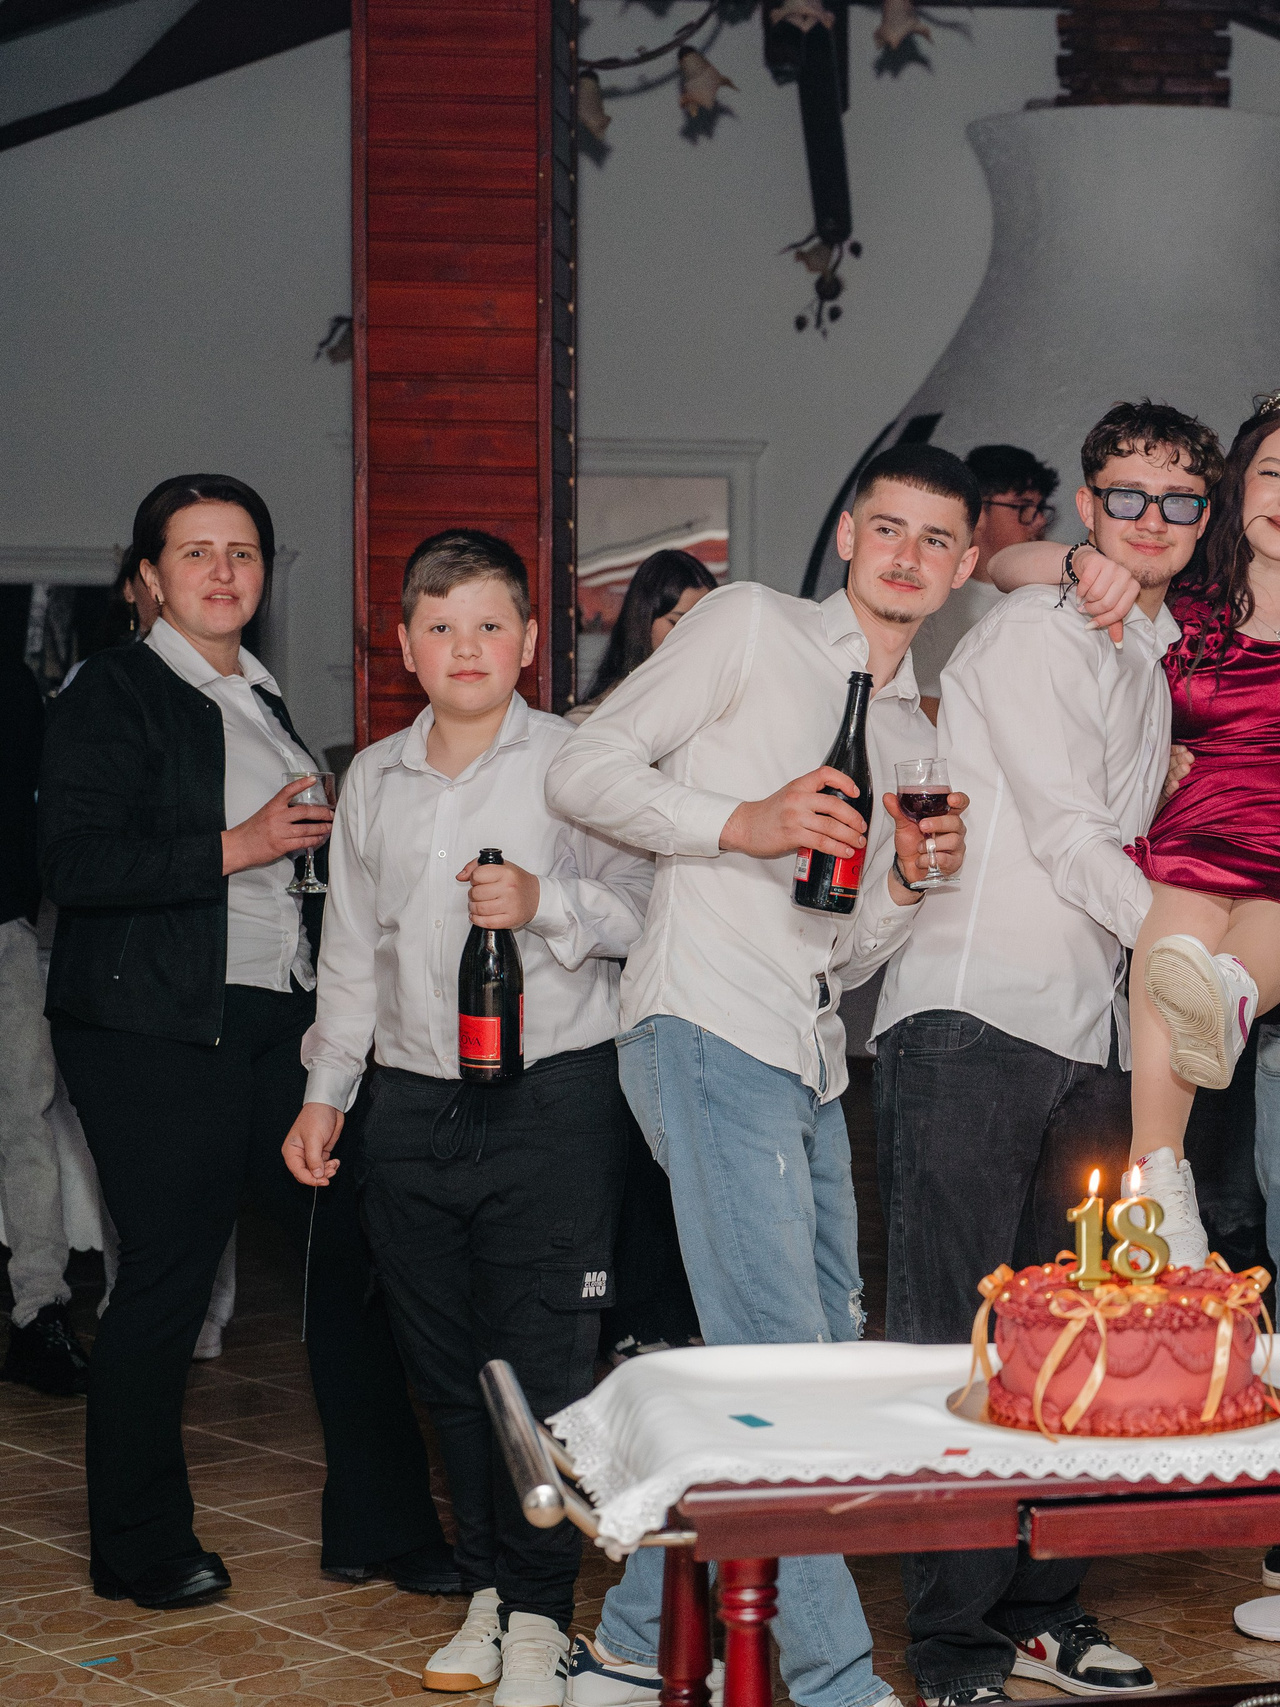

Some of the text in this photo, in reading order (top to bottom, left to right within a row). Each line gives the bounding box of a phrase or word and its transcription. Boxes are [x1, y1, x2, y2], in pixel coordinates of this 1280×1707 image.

[460, 1034, 481, 1047] OVA
[1066, 1197, 1170, 1281] 18
[582, 1270, 607, 1298] NO
